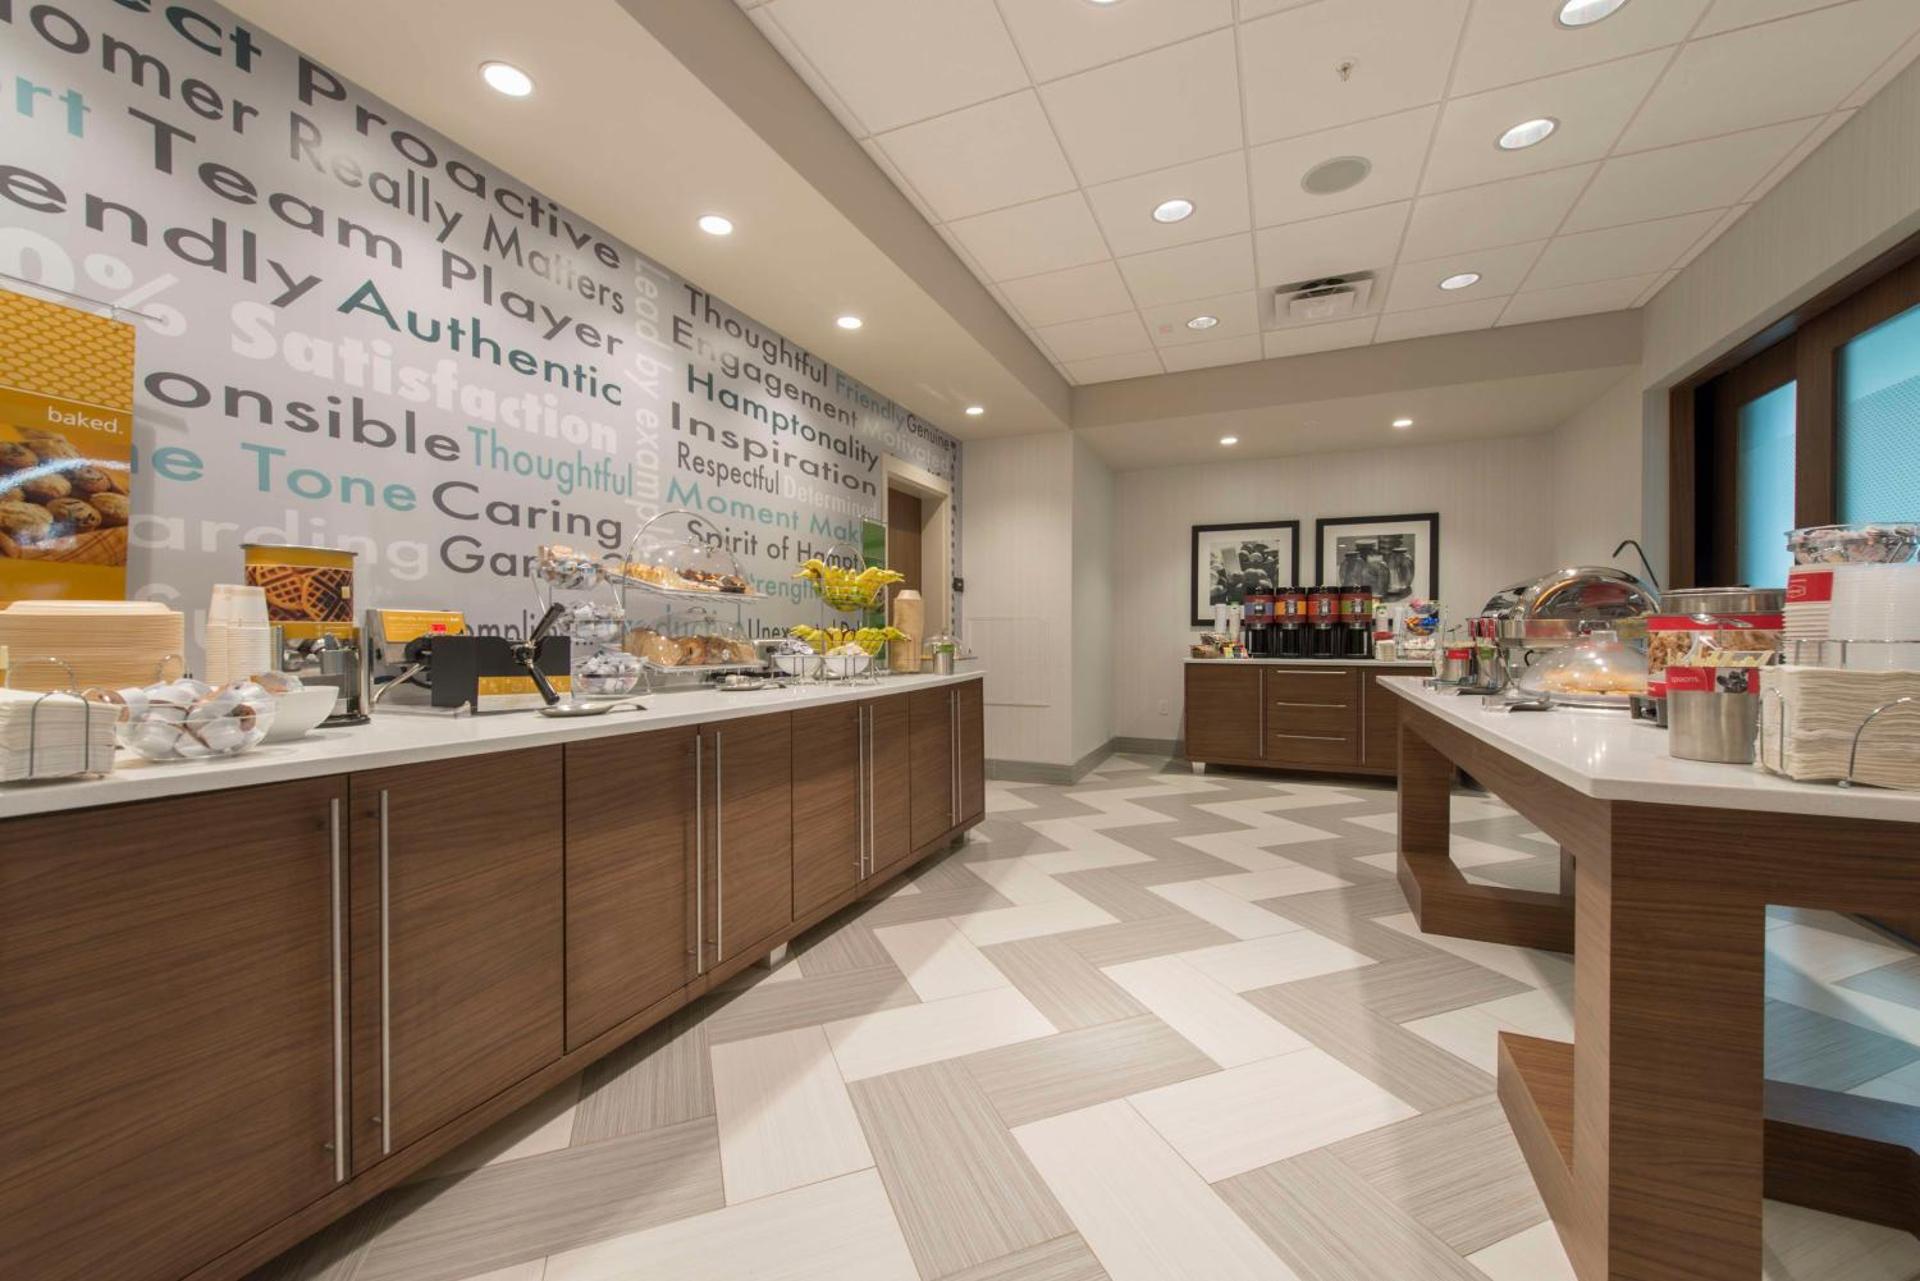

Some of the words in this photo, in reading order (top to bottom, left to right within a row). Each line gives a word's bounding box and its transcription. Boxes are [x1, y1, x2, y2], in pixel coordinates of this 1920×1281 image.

[113, 0, 261, 73] ct
[299, 56, 621, 269] Proactive
[128, 106, 402, 268] Team
[442, 249, 623, 355] Player
[290, 111, 462, 243] Really
[483, 214, 624, 314] Matters
[0, 165, 323, 308] endly
[337, 279, 621, 406] Authentic
[634, 257, 673, 351] Lead
[230, 300, 618, 450] Satisfaction
[624, 351, 673, 398] by
[684, 283, 828, 387] Thoughtful
[48, 406, 124, 435] baked.
[144, 371, 460, 461] onsible
[672, 315, 857, 428] Engagement
[862, 416, 951, 470] Motivated
[687, 363, 879, 472] Hamptonality
[835, 373, 906, 431] Friendly
[907, 413, 950, 451] Genuine
[241, 442, 417, 511] Tone
[467, 425, 634, 497] Thoughtful
[625, 406, 673, 554] example
[672, 401, 877, 496] Inspiration
[678, 441, 780, 495] Respectful
[432, 481, 622, 550] Caring
[666, 477, 799, 528] Moment
[687, 519, 758, 558] Spirit
[767, 536, 789, 560] of
